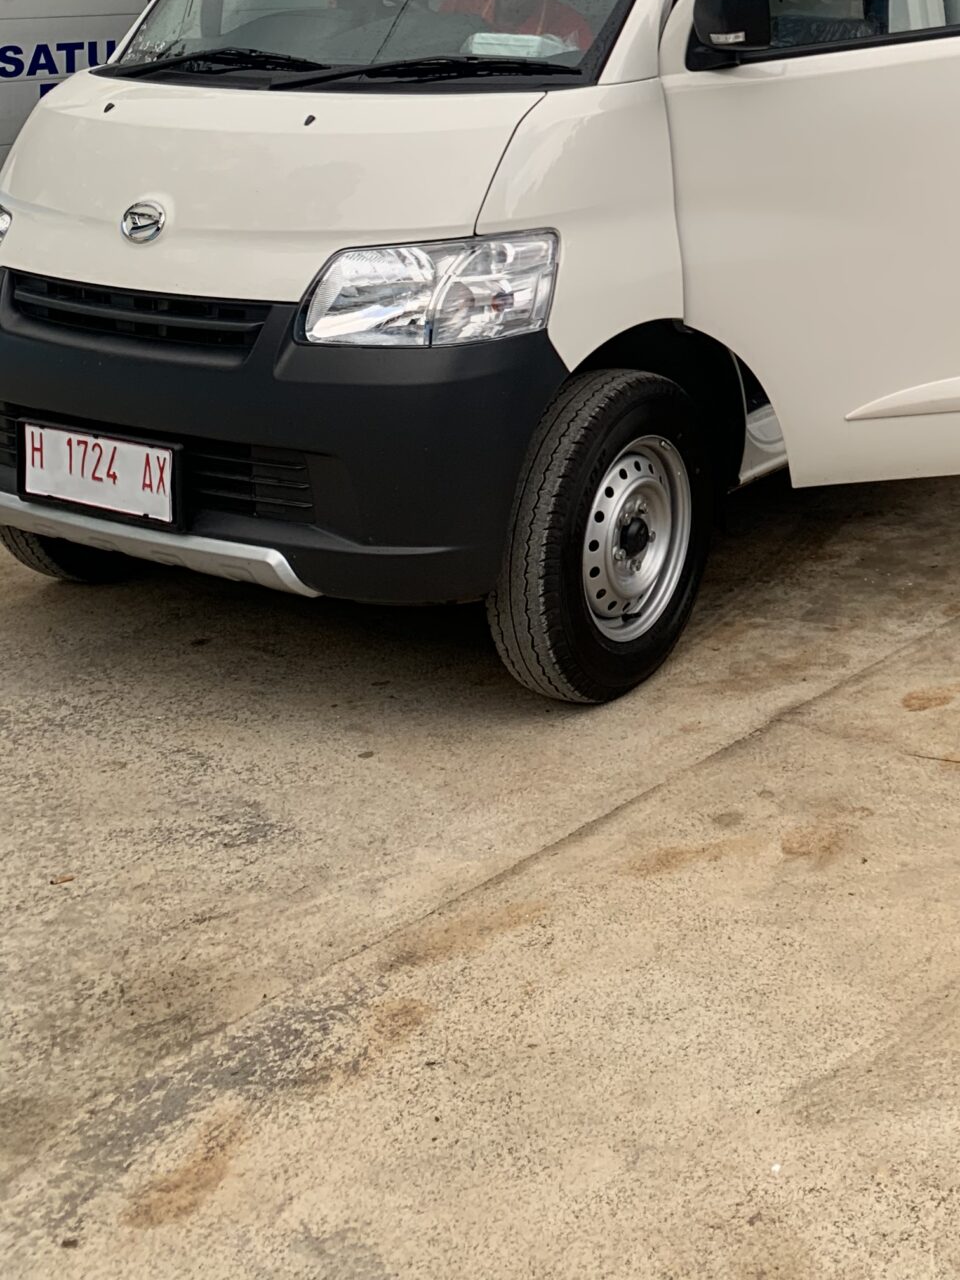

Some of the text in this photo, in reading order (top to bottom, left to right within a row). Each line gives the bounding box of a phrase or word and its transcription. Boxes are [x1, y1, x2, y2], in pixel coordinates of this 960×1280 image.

[31, 431, 168, 496] H 1724 AX
